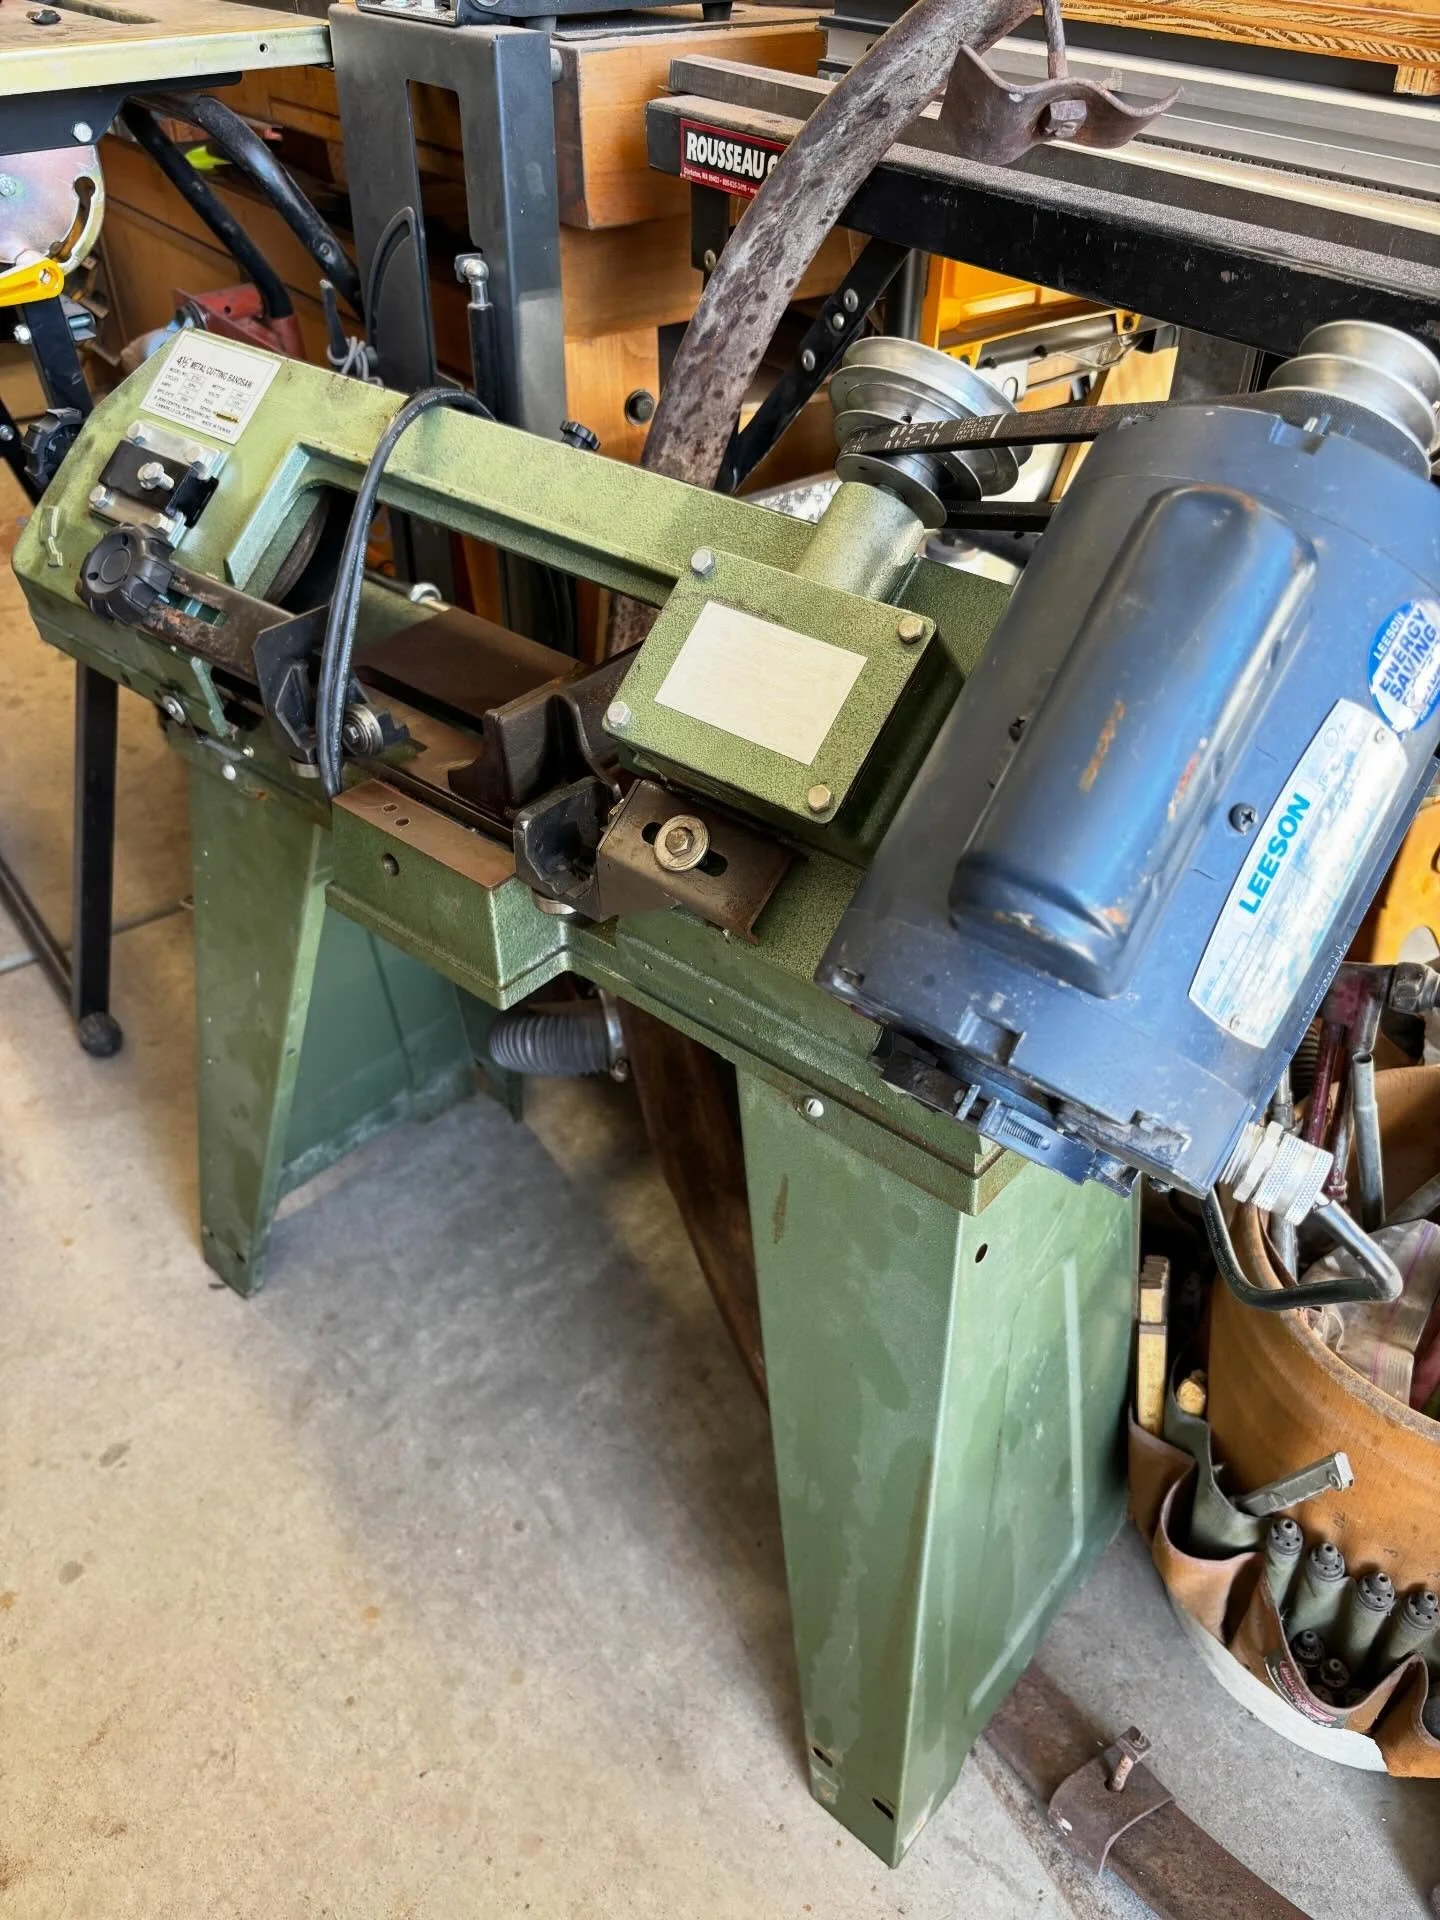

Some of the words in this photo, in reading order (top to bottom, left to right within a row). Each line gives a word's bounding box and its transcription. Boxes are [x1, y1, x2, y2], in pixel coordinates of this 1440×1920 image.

[686, 132, 766, 179] ROUSSEAU
[191, 362, 205, 373] METAL
[206, 366, 227, 380] CUTTING
[227, 373, 252, 388] BANDSAW
[1373, 611, 1406, 661] LEESON
[1379, 607, 1425, 692] ENERGY
[1389, 623, 1436, 702] SAVING
[1238, 792, 1311, 914] LEESON
